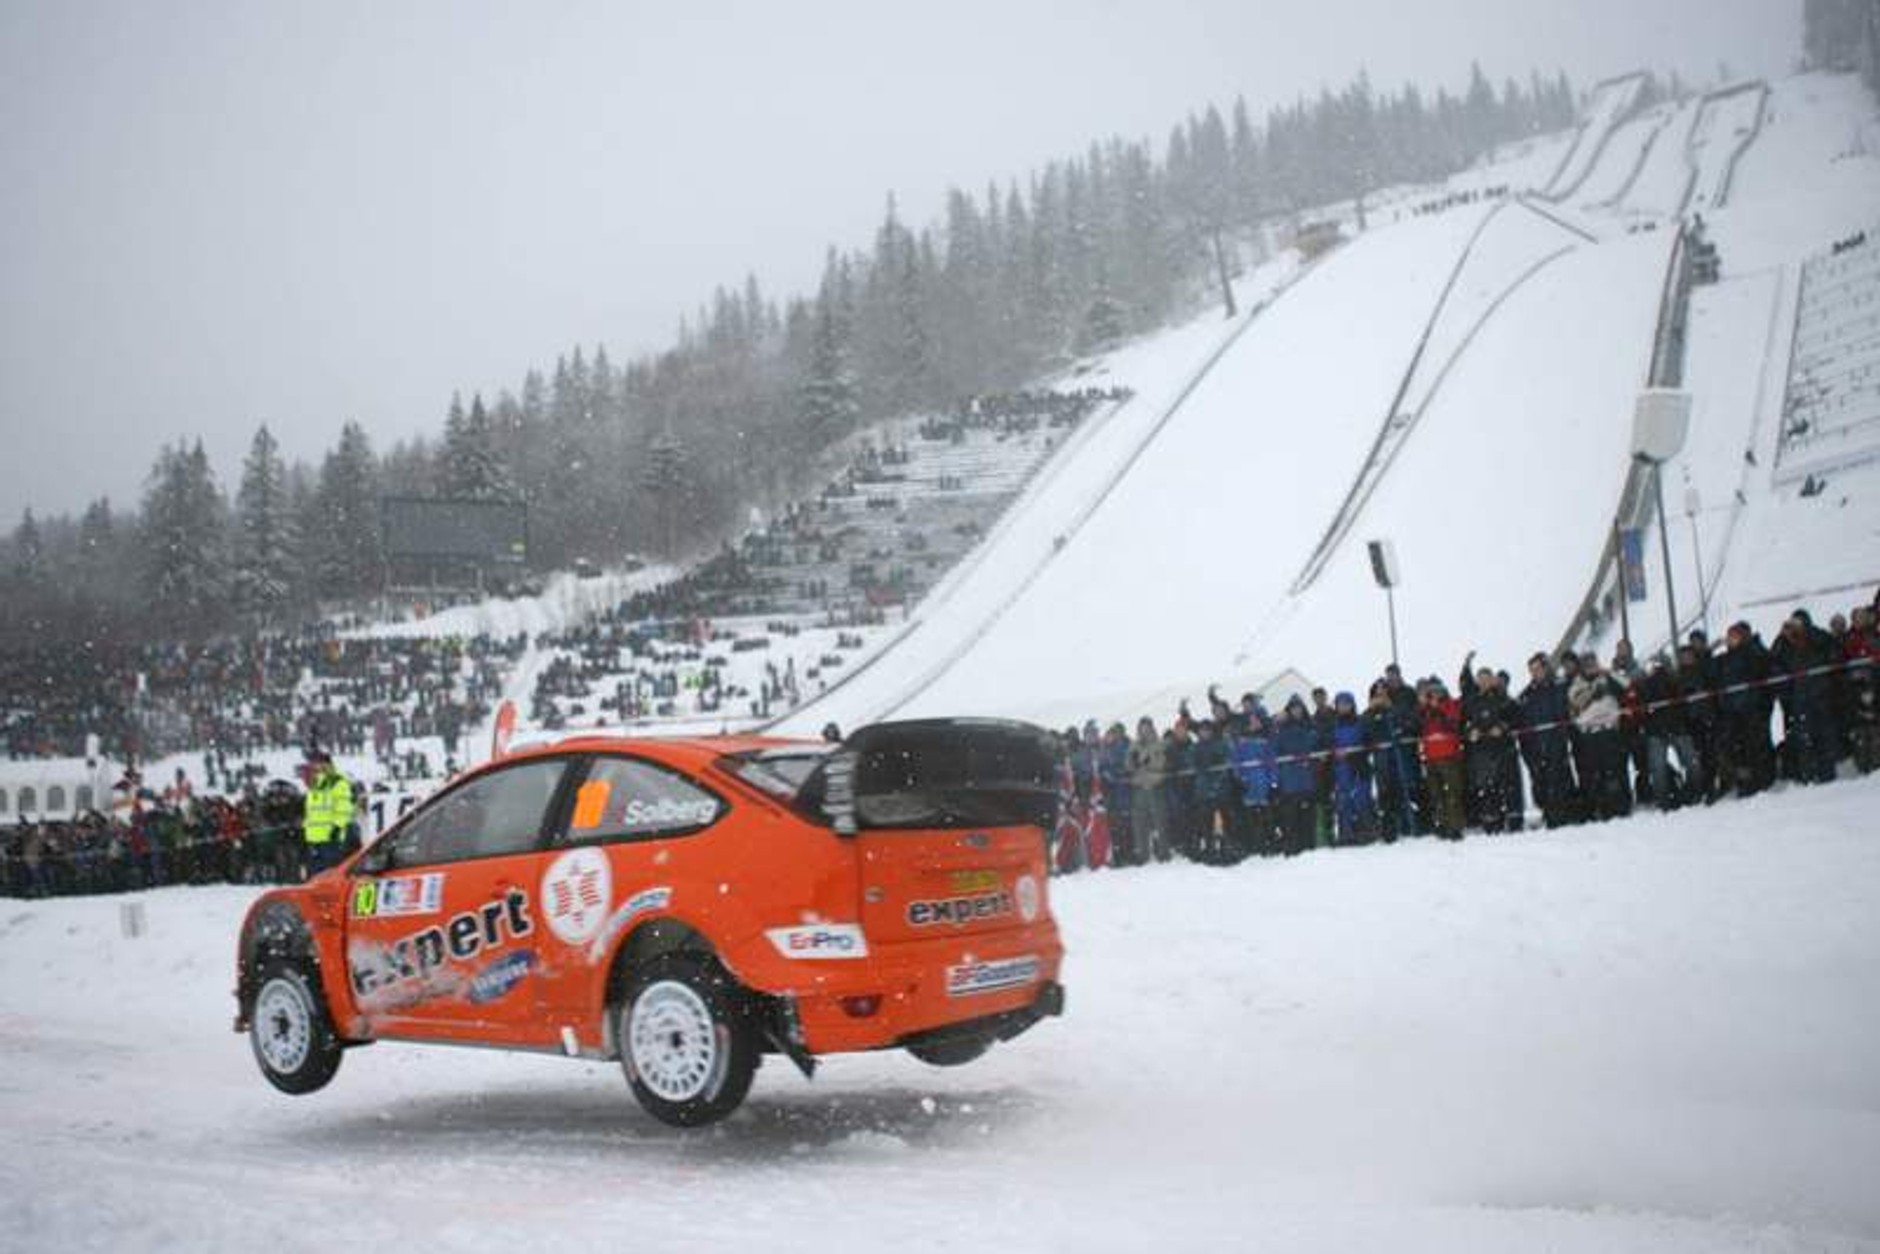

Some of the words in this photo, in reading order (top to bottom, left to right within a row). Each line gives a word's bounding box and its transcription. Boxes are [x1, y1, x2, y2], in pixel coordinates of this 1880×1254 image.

[624, 798, 719, 826] Solberg
[908, 892, 1013, 924] expert
[789, 932, 855, 951] EnPro
